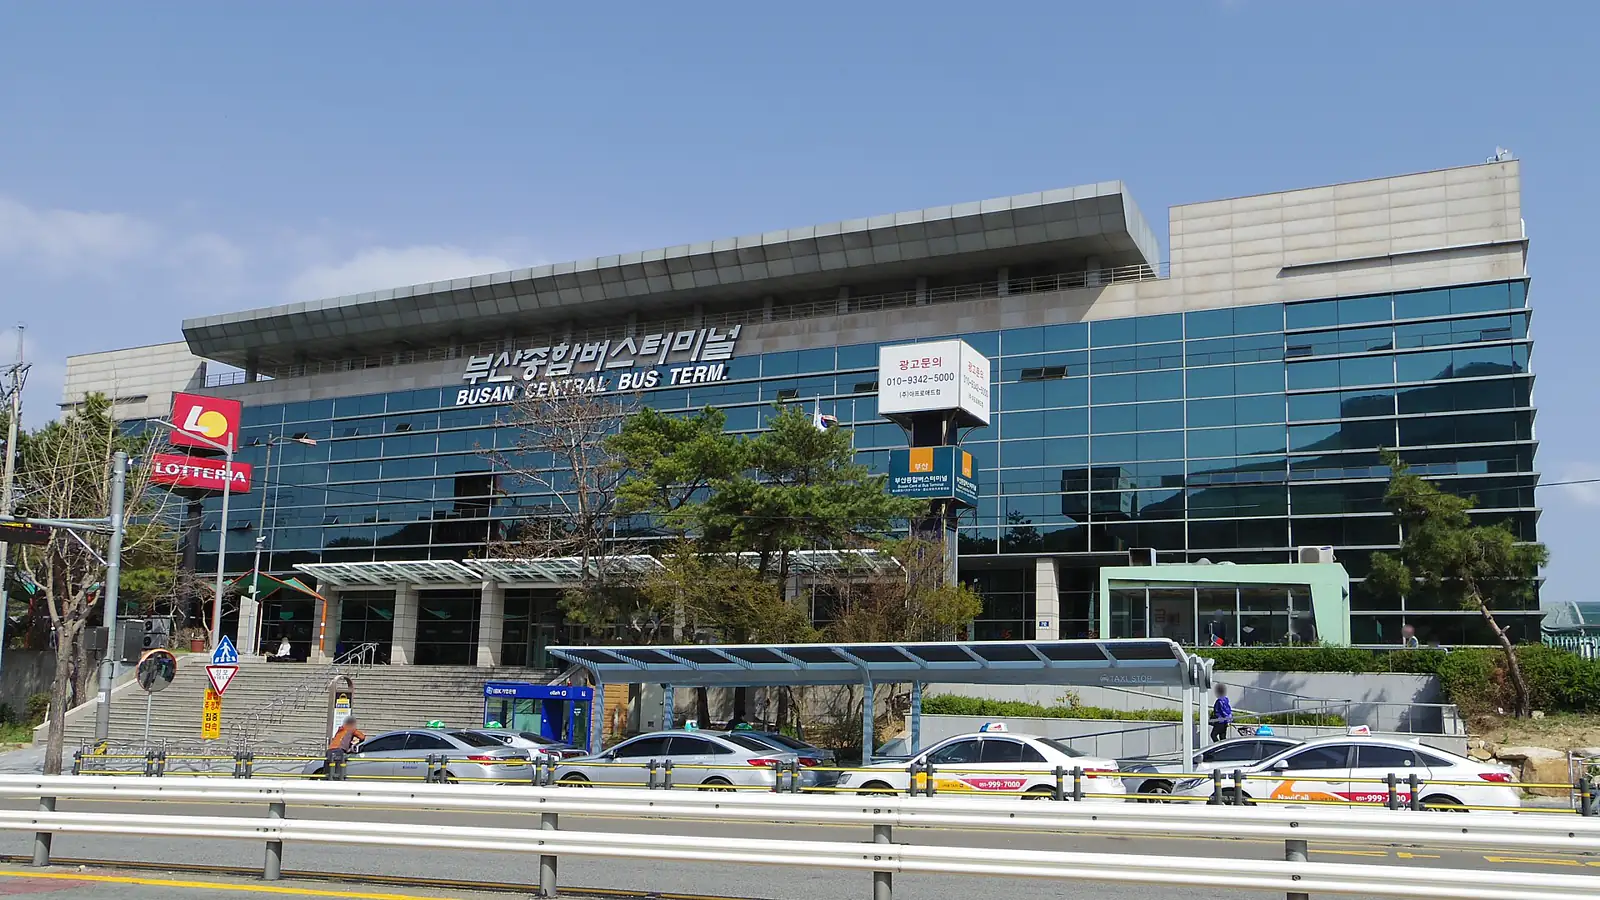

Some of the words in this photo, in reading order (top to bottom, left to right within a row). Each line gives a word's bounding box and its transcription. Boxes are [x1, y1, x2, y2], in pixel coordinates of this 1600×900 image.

[462, 324, 742, 384] 부산종합버스터미널
[899, 356, 942, 371] 광고문의
[456, 385, 515, 405] BUSAN
[525, 376, 606, 398] CENTRAL
[618, 370, 658, 390] BUS
[670, 363, 728, 385] TERM.
[886, 372, 955, 386] 010-9342-5000
[155, 462, 246, 483] LOTTERIA
[1110, 675, 1128, 683] TAXI
[1131, 675, 1152, 683] STOP
[205, 712, 218, 722] 집중
